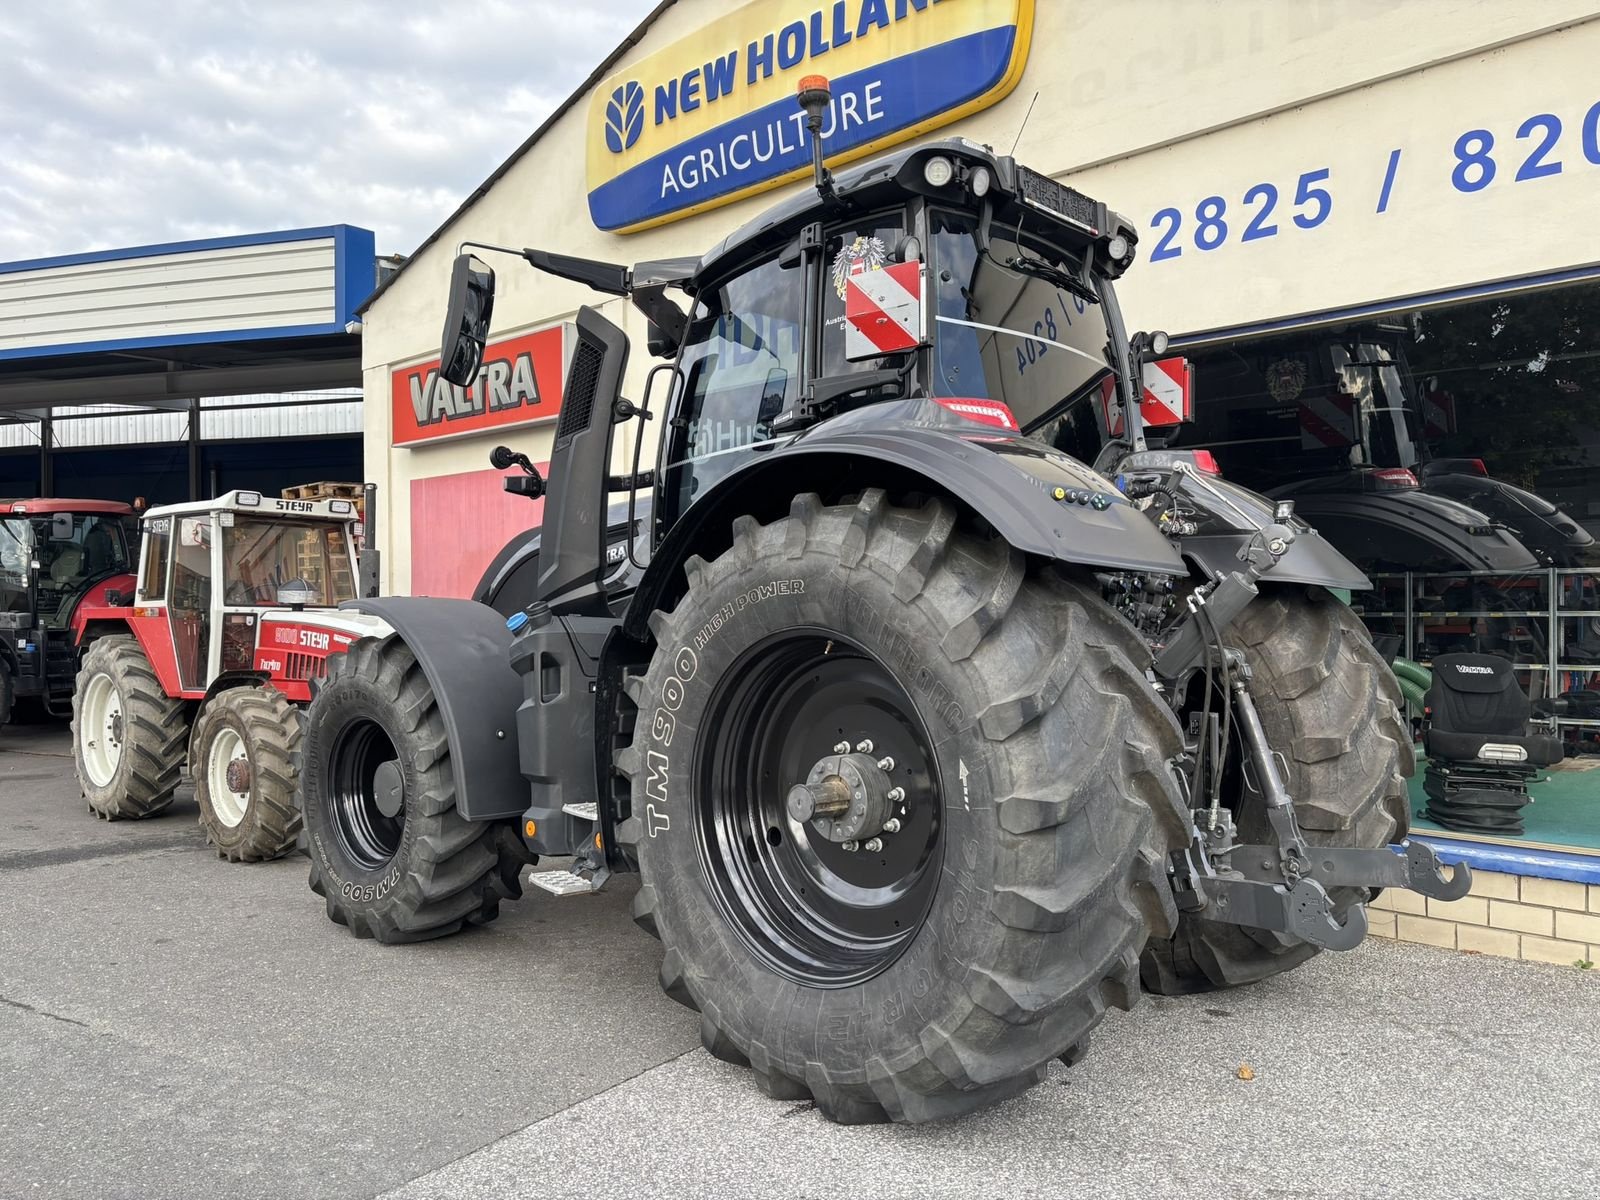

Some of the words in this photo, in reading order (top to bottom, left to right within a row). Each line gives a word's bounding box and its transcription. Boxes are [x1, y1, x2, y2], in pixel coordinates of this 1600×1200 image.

[655, 50, 738, 126] NEW
[747, 0, 950, 86] HOLLA
[661, 80, 884, 198] AGRICULTURE
[1149, 167, 1333, 263] 2825
[1376, 149, 1402, 214] /
[408, 351, 542, 428] VALTRA
[717, 419, 772, 455] Hus
[275, 500, 314, 512] STEYR
[299, 630, 330, 650] STEYR
[645, 646, 698, 838] TM900
[693, 602, 735, 650] HIGH
[735, 579, 805, 611] POWER
[341, 866, 400, 902] TM900
